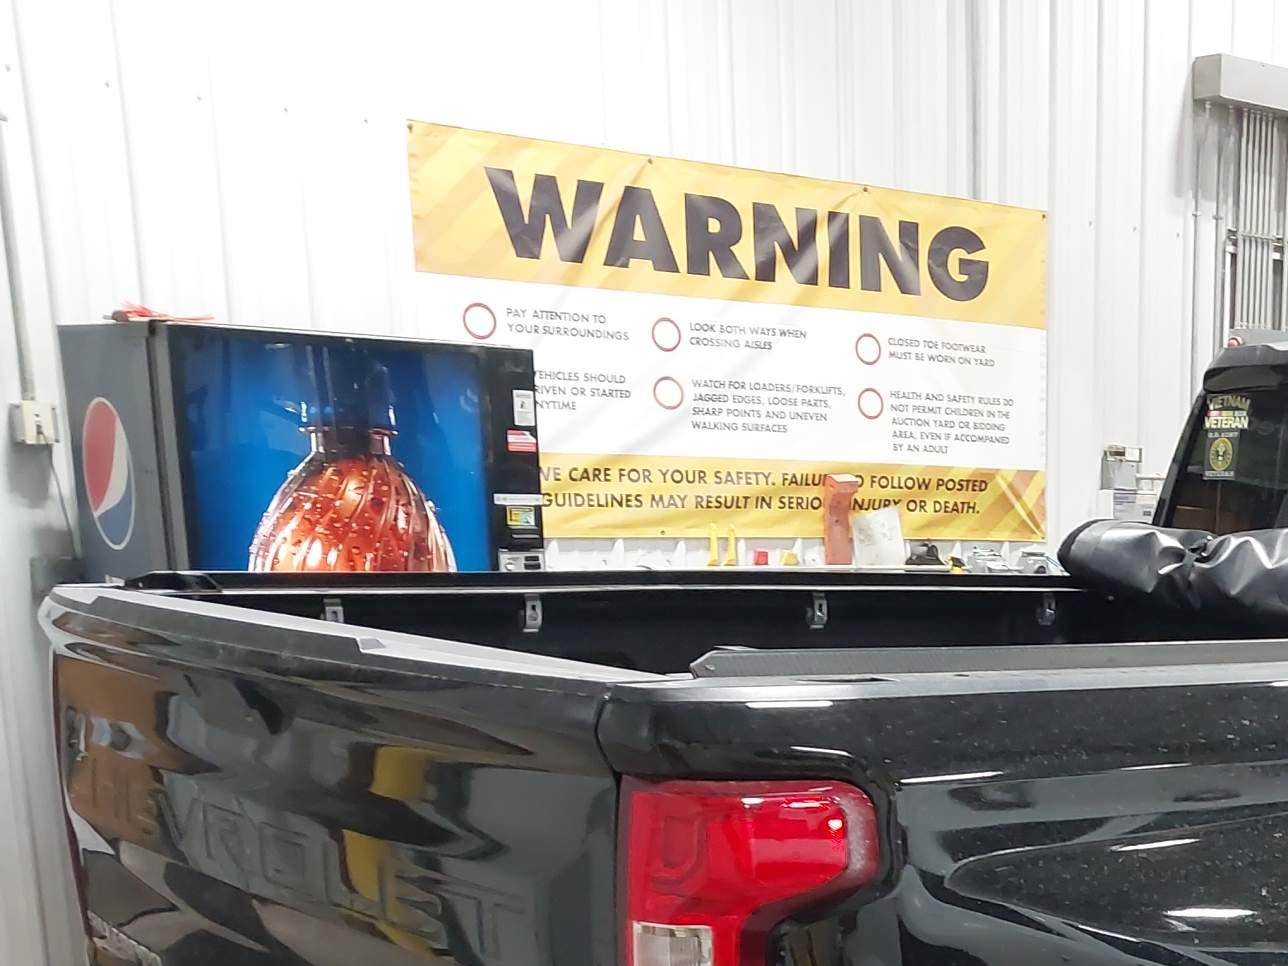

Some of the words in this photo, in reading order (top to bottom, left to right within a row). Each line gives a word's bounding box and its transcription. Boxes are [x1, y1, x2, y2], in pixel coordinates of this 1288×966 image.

[484, 166, 990, 302] WARNING
[506, 307, 527, 318] PAY
[532, 310, 589, 322] ATTENTION
[592, 314, 607, 324] TO
[507, 322, 540, 334] YOUR
[541, 325, 630, 340] SURROUNDINGS
[689, 322, 716, 333] LOOK
[719, 324, 746, 335] BOTH
[749, 326, 777, 337] WAYS
[778, 328, 807, 339] WHEN
[689, 336, 741, 349] CROSSING
[744, 340, 773, 351] AISLES
[887, 337, 921, 349] CLOSED
[923, 339, 939, 350] TOE
[941, 342, 987, 353] FOOTWEAR
[888, 350, 912, 361] MUST
[914, 352, 925, 362] BE
[928, 353, 957, 364] WORN
[958, 356, 972, 366] ON
[973, 357, 996, 367] YARD
[583, 373, 626, 385] SHOULD
[534, 384, 567, 396] RIVEN
[570, 386, 587, 397] OR
[590, 387, 632, 400] STARTED
[691, 379, 726, 390] WATCH
[728, 381, 746, 391] FOR
[749, 382, 846, 396] LOADERS/FORKLIFTS,
[536, 399, 577, 411] NYTIME
[693, 393, 729, 404] JAGGED
[732, 395, 765, 407] EDGES,
[768, 397, 798, 407] LOOSE
[801, 398, 832, 409] PARTS,
[890, 391, 922, 401] HEALTH
[925, 393, 945, 402] AND
[947, 394, 975, 404] SAFETY
[978, 396, 1001, 406] RULES
[1003, 398, 1014, 407] DO
[1208, 396, 1251, 410] VIETNAM
[692, 407, 723, 417] SHARP
[727, 409, 762, 419] POINTS
[765, 411, 786, 420] AND
[789, 412, 828, 422] UNEVEN
[890, 404, 909, 413] NOT
[912, 405, 942, 415] PERMIT
[944, 406, 984, 418] CHILDREN
[986, 410, 996, 419] IN
[998, 410, 1011, 419] THE
[691, 420, 739, 432] WALKING
[741, 423, 788, 434] SURFACES
[892, 417, 930, 428] AUCTION
[934, 419, 956, 429] YARD
[958, 421, 971, 430] OR
[973, 422, 1006, 432] BIDDING
[1205, 416, 1249, 429] VETERAN
[892, 430, 917, 440] AREA,
[920, 432, 942, 441] EVEN
[944, 433, 951, 442] IF
[893, 443, 904, 453] BY
[907, 444, 920, 453] AN
[923, 445, 949, 455] ADULT
[568, 467, 611, 483] CARE
[618, 469, 653, 483] FOR
[658, 468, 708, 485] YOUR
[713, 471, 776, 487] SAFETY.
[870, 475, 932, 492] FOLLOW
[935, 476, 989, 493] POSTED
[542, 492, 644, 509] GUIDELINES
[649, 494, 689, 509] MAY
[694, 495, 751, 511] RESULT
[755, 496, 773, 510] IN
[777, 496, 823, 511] SERIO
[906, 500, 928, 513] OR
[933, 500, 981, 515] DEATH.
